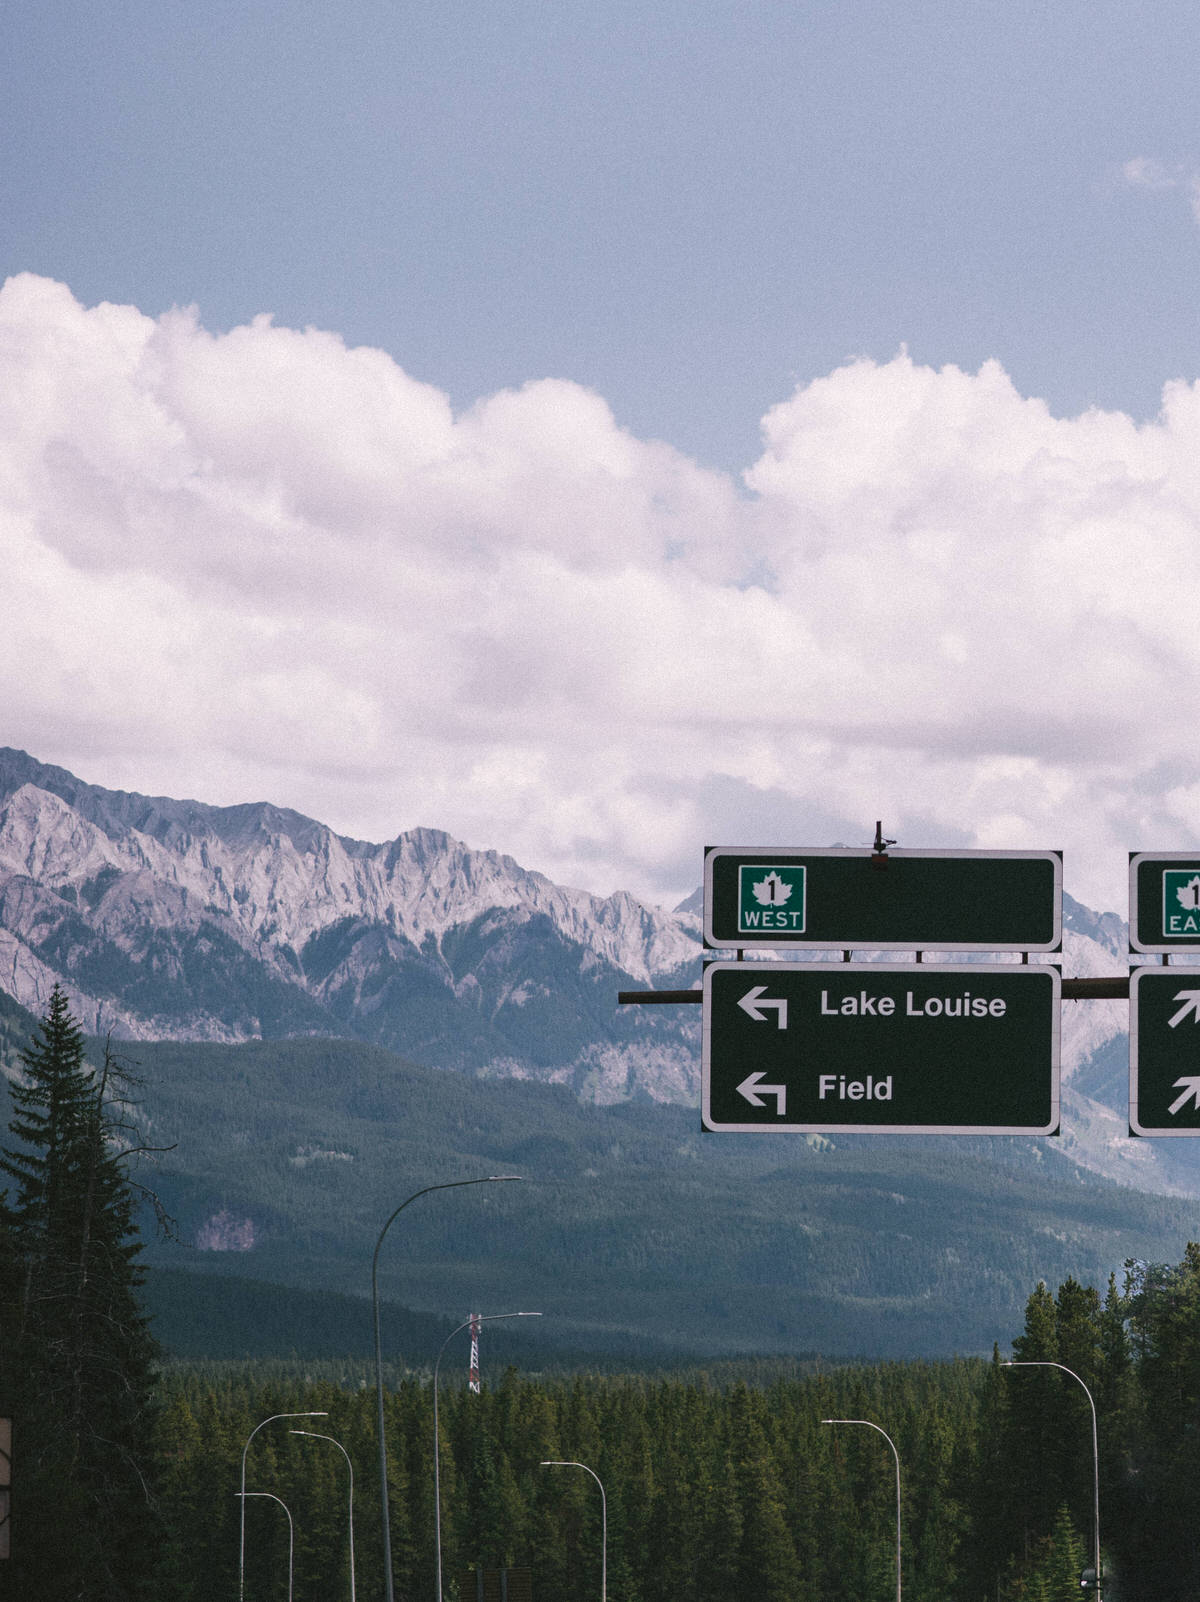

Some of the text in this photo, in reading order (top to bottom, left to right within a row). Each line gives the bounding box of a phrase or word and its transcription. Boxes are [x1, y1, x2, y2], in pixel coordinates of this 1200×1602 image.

[768, 879, 776, 901] 1
[1191, 884, 1200, 906] 1
[744, 911, 801, 927] WEST
[821, 990, 1007, 1018] Lake Louise
[818, 1074, 893, 1101] Field
